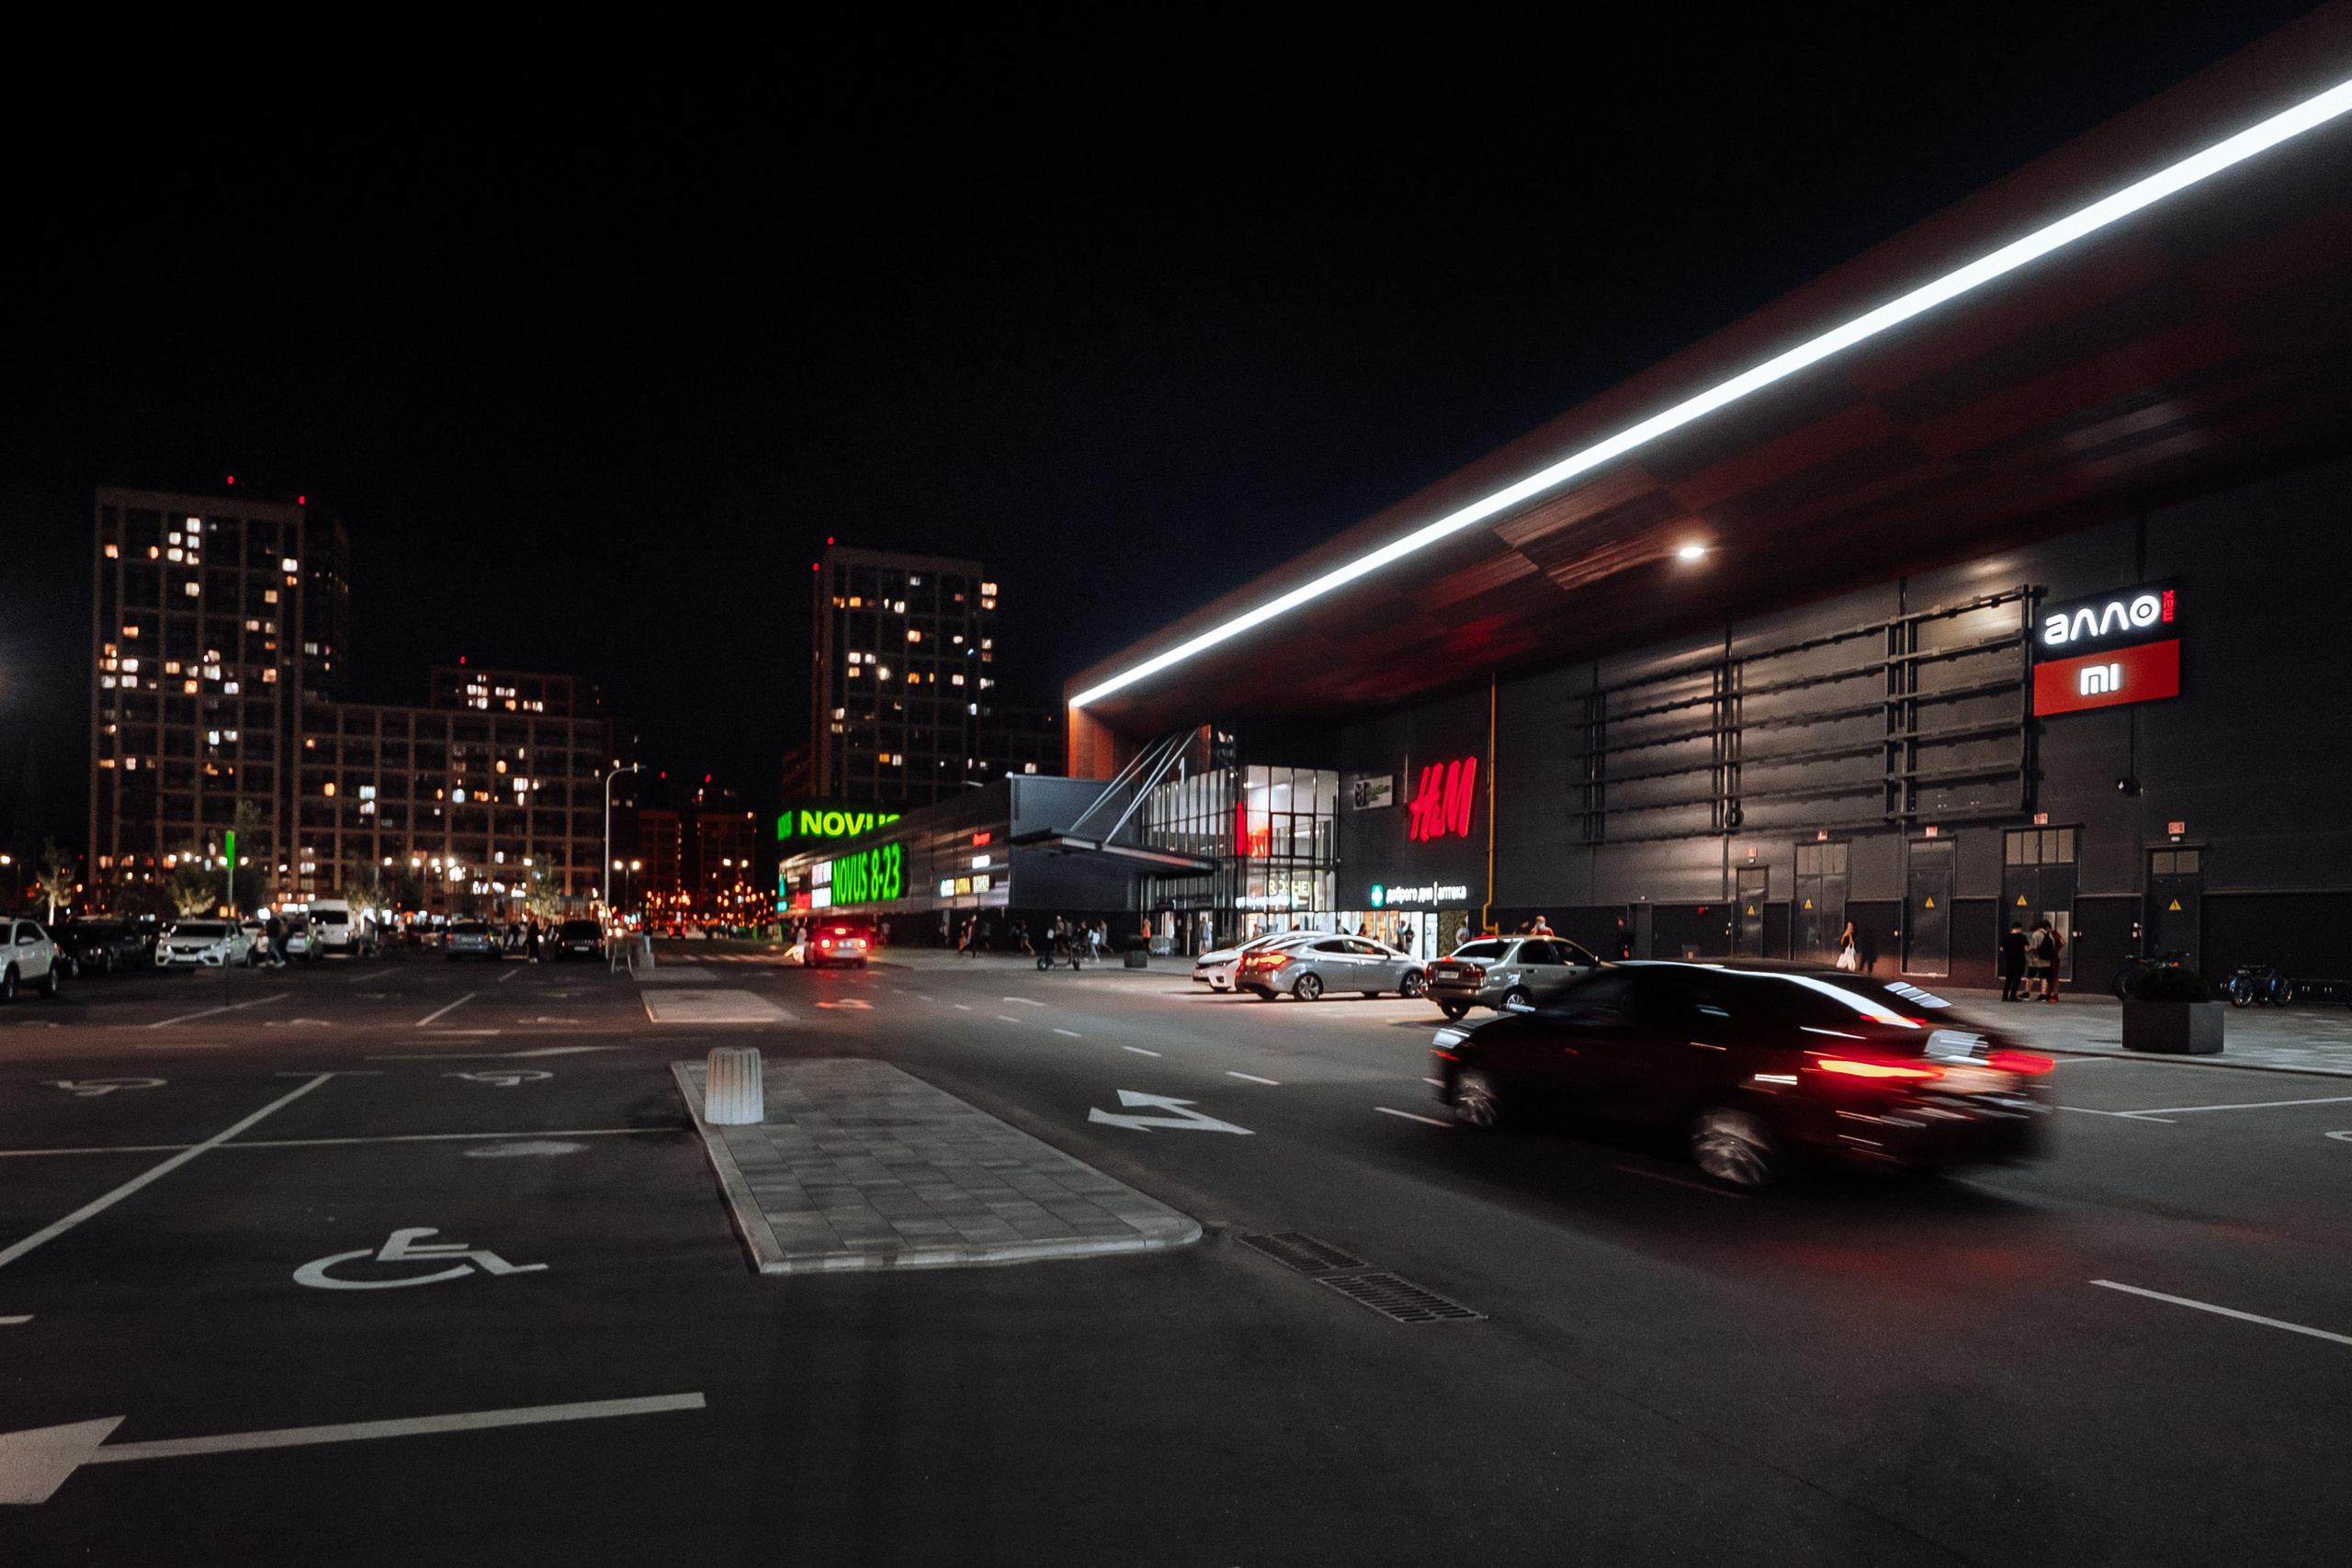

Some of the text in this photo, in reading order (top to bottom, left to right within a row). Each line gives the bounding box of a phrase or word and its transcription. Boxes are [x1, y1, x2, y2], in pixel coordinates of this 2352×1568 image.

[1409, 756, 1477, 842] H&M
[832, 851, 868, 905] NOVUS
[871, 842, 901, 902] 8-23
[1438, 886, 1467, 900] аптека
